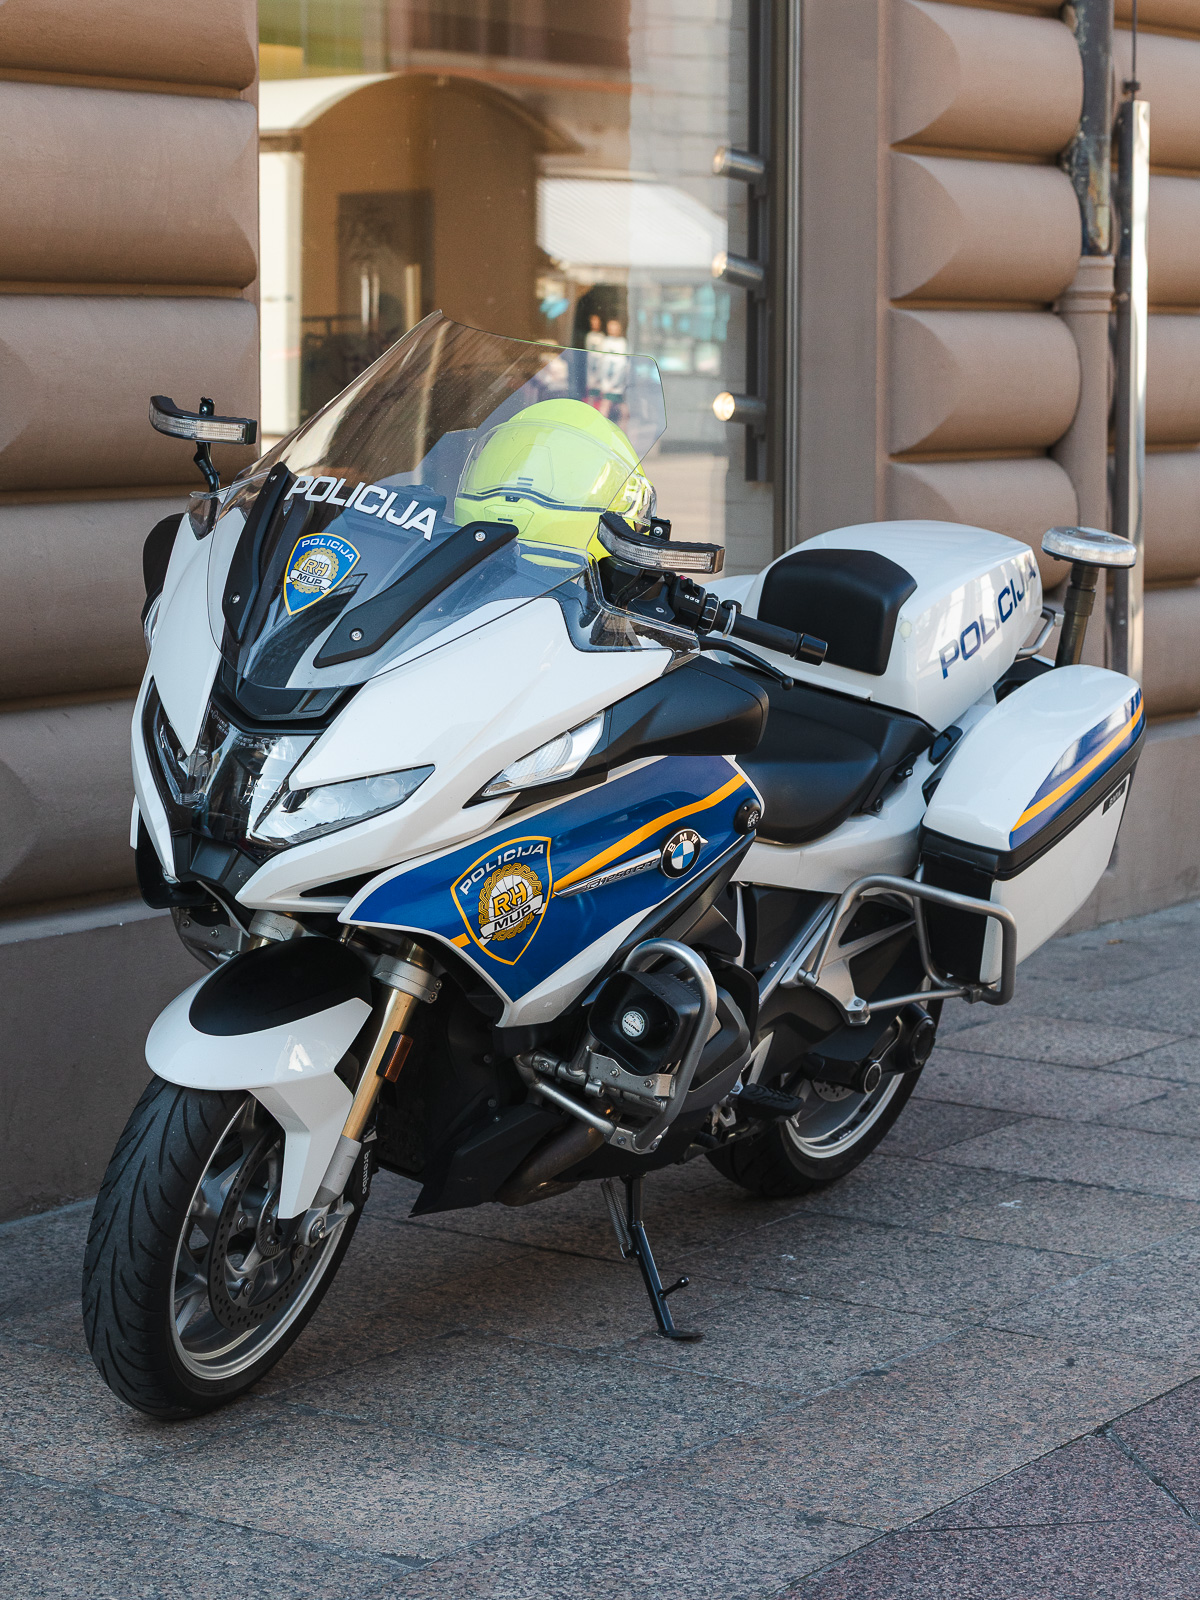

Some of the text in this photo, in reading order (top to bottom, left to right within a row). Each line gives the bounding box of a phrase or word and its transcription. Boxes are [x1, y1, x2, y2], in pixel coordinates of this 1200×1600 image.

[284, 476, 437, 541] POLICIJA
[301, 537, 355, 563] POLICIJA
[296, 573, 323, 585] MUP
[302, 559, 330, 577] RH
[667, 832, 699, 853] BMW
[459, 844, 544, 896] POLICIJA
[492, 881, 528, 918] RH
[493, 905, 531, 931] MUP
[362, 1149, 371, 1195] brembo
